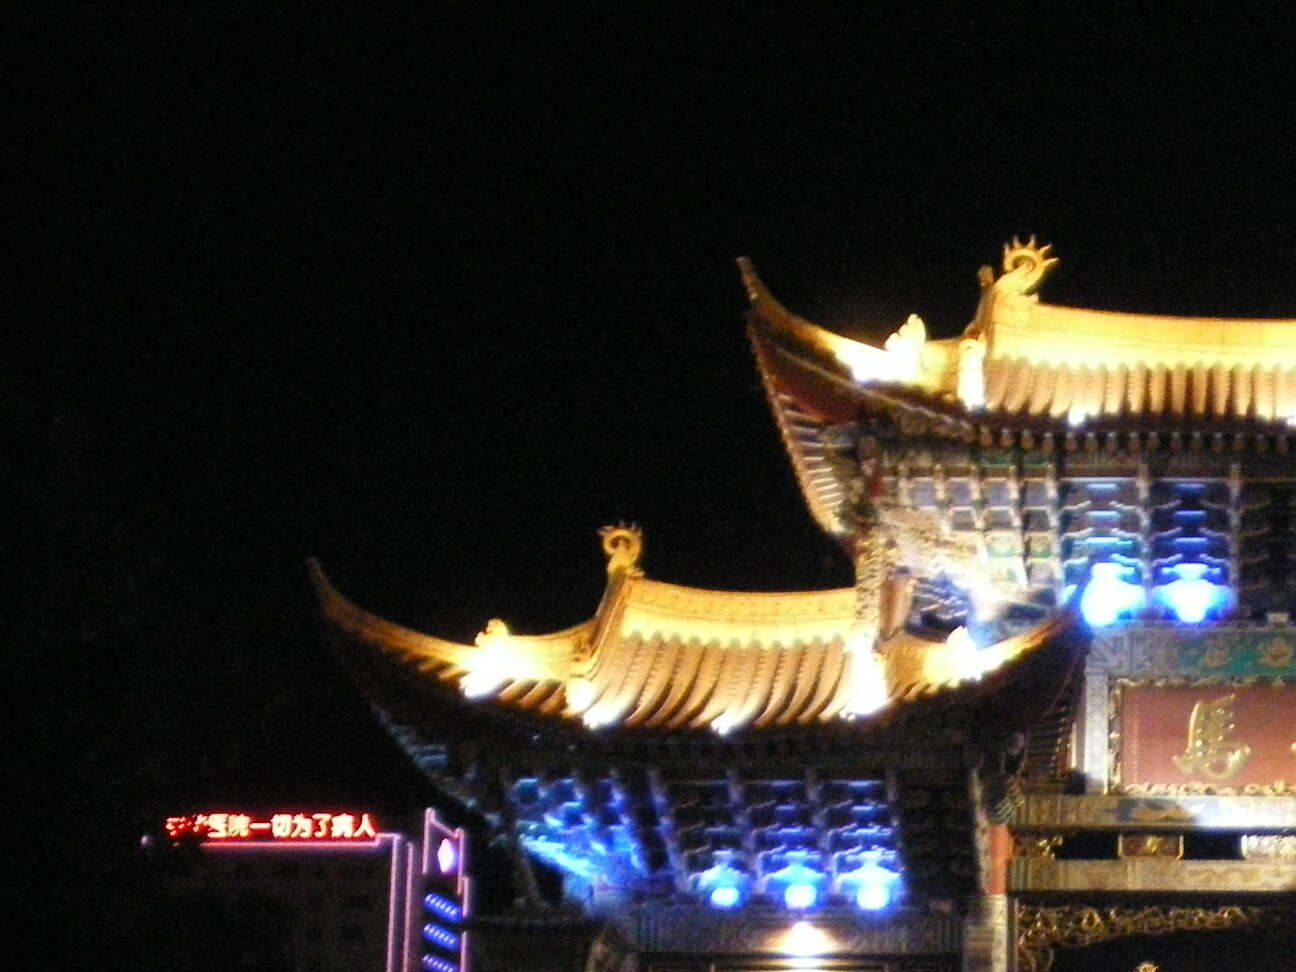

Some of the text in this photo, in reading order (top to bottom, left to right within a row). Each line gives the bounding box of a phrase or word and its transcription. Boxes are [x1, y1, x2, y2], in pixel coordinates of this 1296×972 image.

[165, 812, 378, 839] 医院一切为了病人
